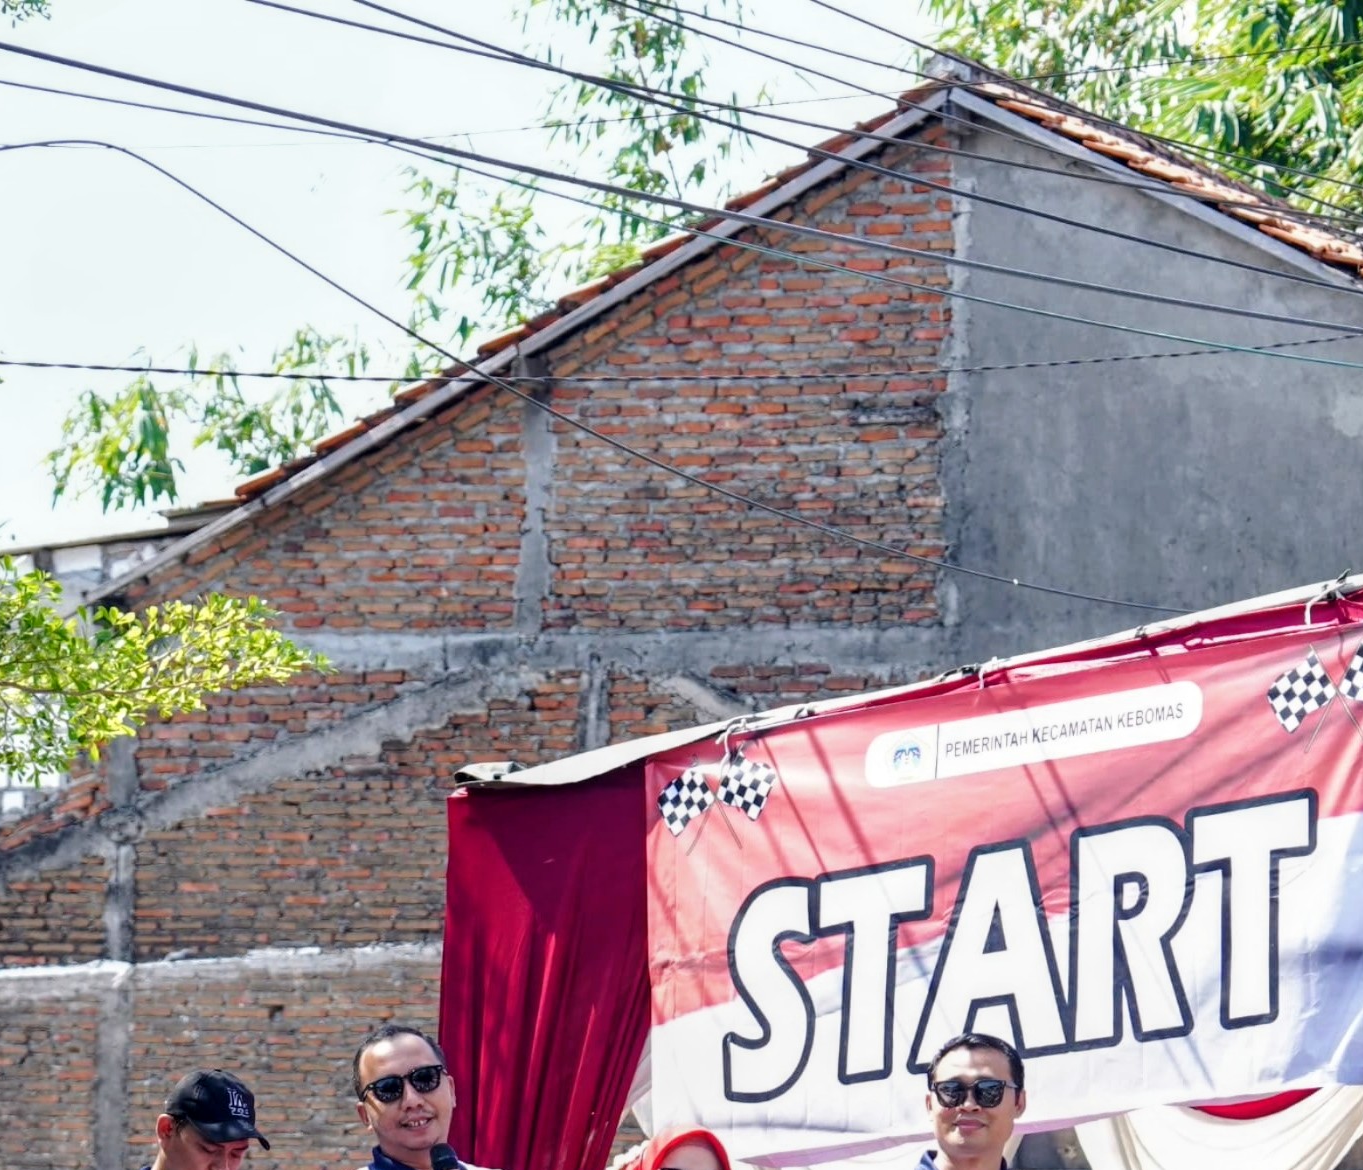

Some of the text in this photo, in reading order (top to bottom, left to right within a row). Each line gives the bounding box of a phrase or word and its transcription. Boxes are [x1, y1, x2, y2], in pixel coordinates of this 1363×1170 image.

[945, 702, 1184, 758] PEMERINTAH KECAMATAN KEBOMAS
[722, 787, 1319, 1104] START
